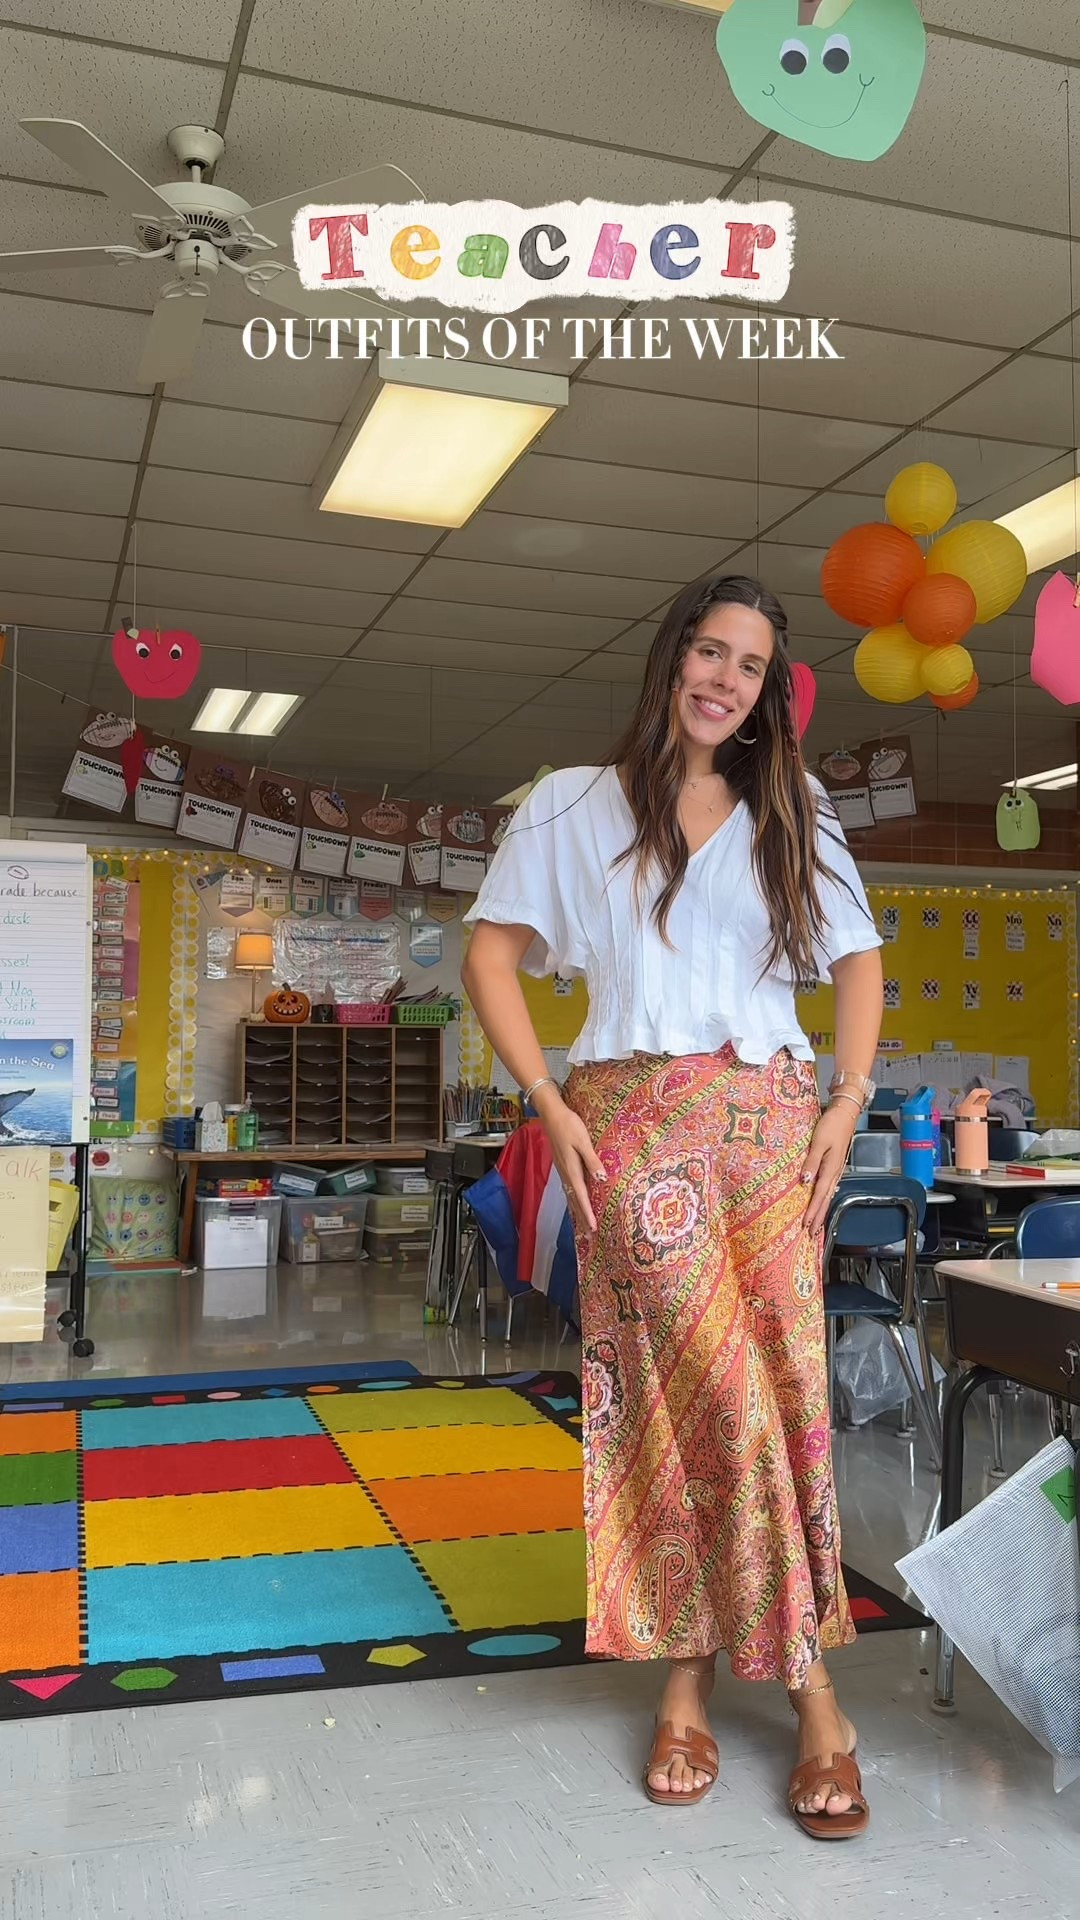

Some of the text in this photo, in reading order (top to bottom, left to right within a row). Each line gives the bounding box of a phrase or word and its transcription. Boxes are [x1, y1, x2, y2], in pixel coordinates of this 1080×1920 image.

[188, 798, 235, 819] TOUCHDOWN!
[250, 819, 296, 840] TOUCHDOWN!
[356, 842, 401, 857] TOUCHDOWN!
[9, 1056, 28, 1066] the
[31, 1056, 55, 1070] Sea
